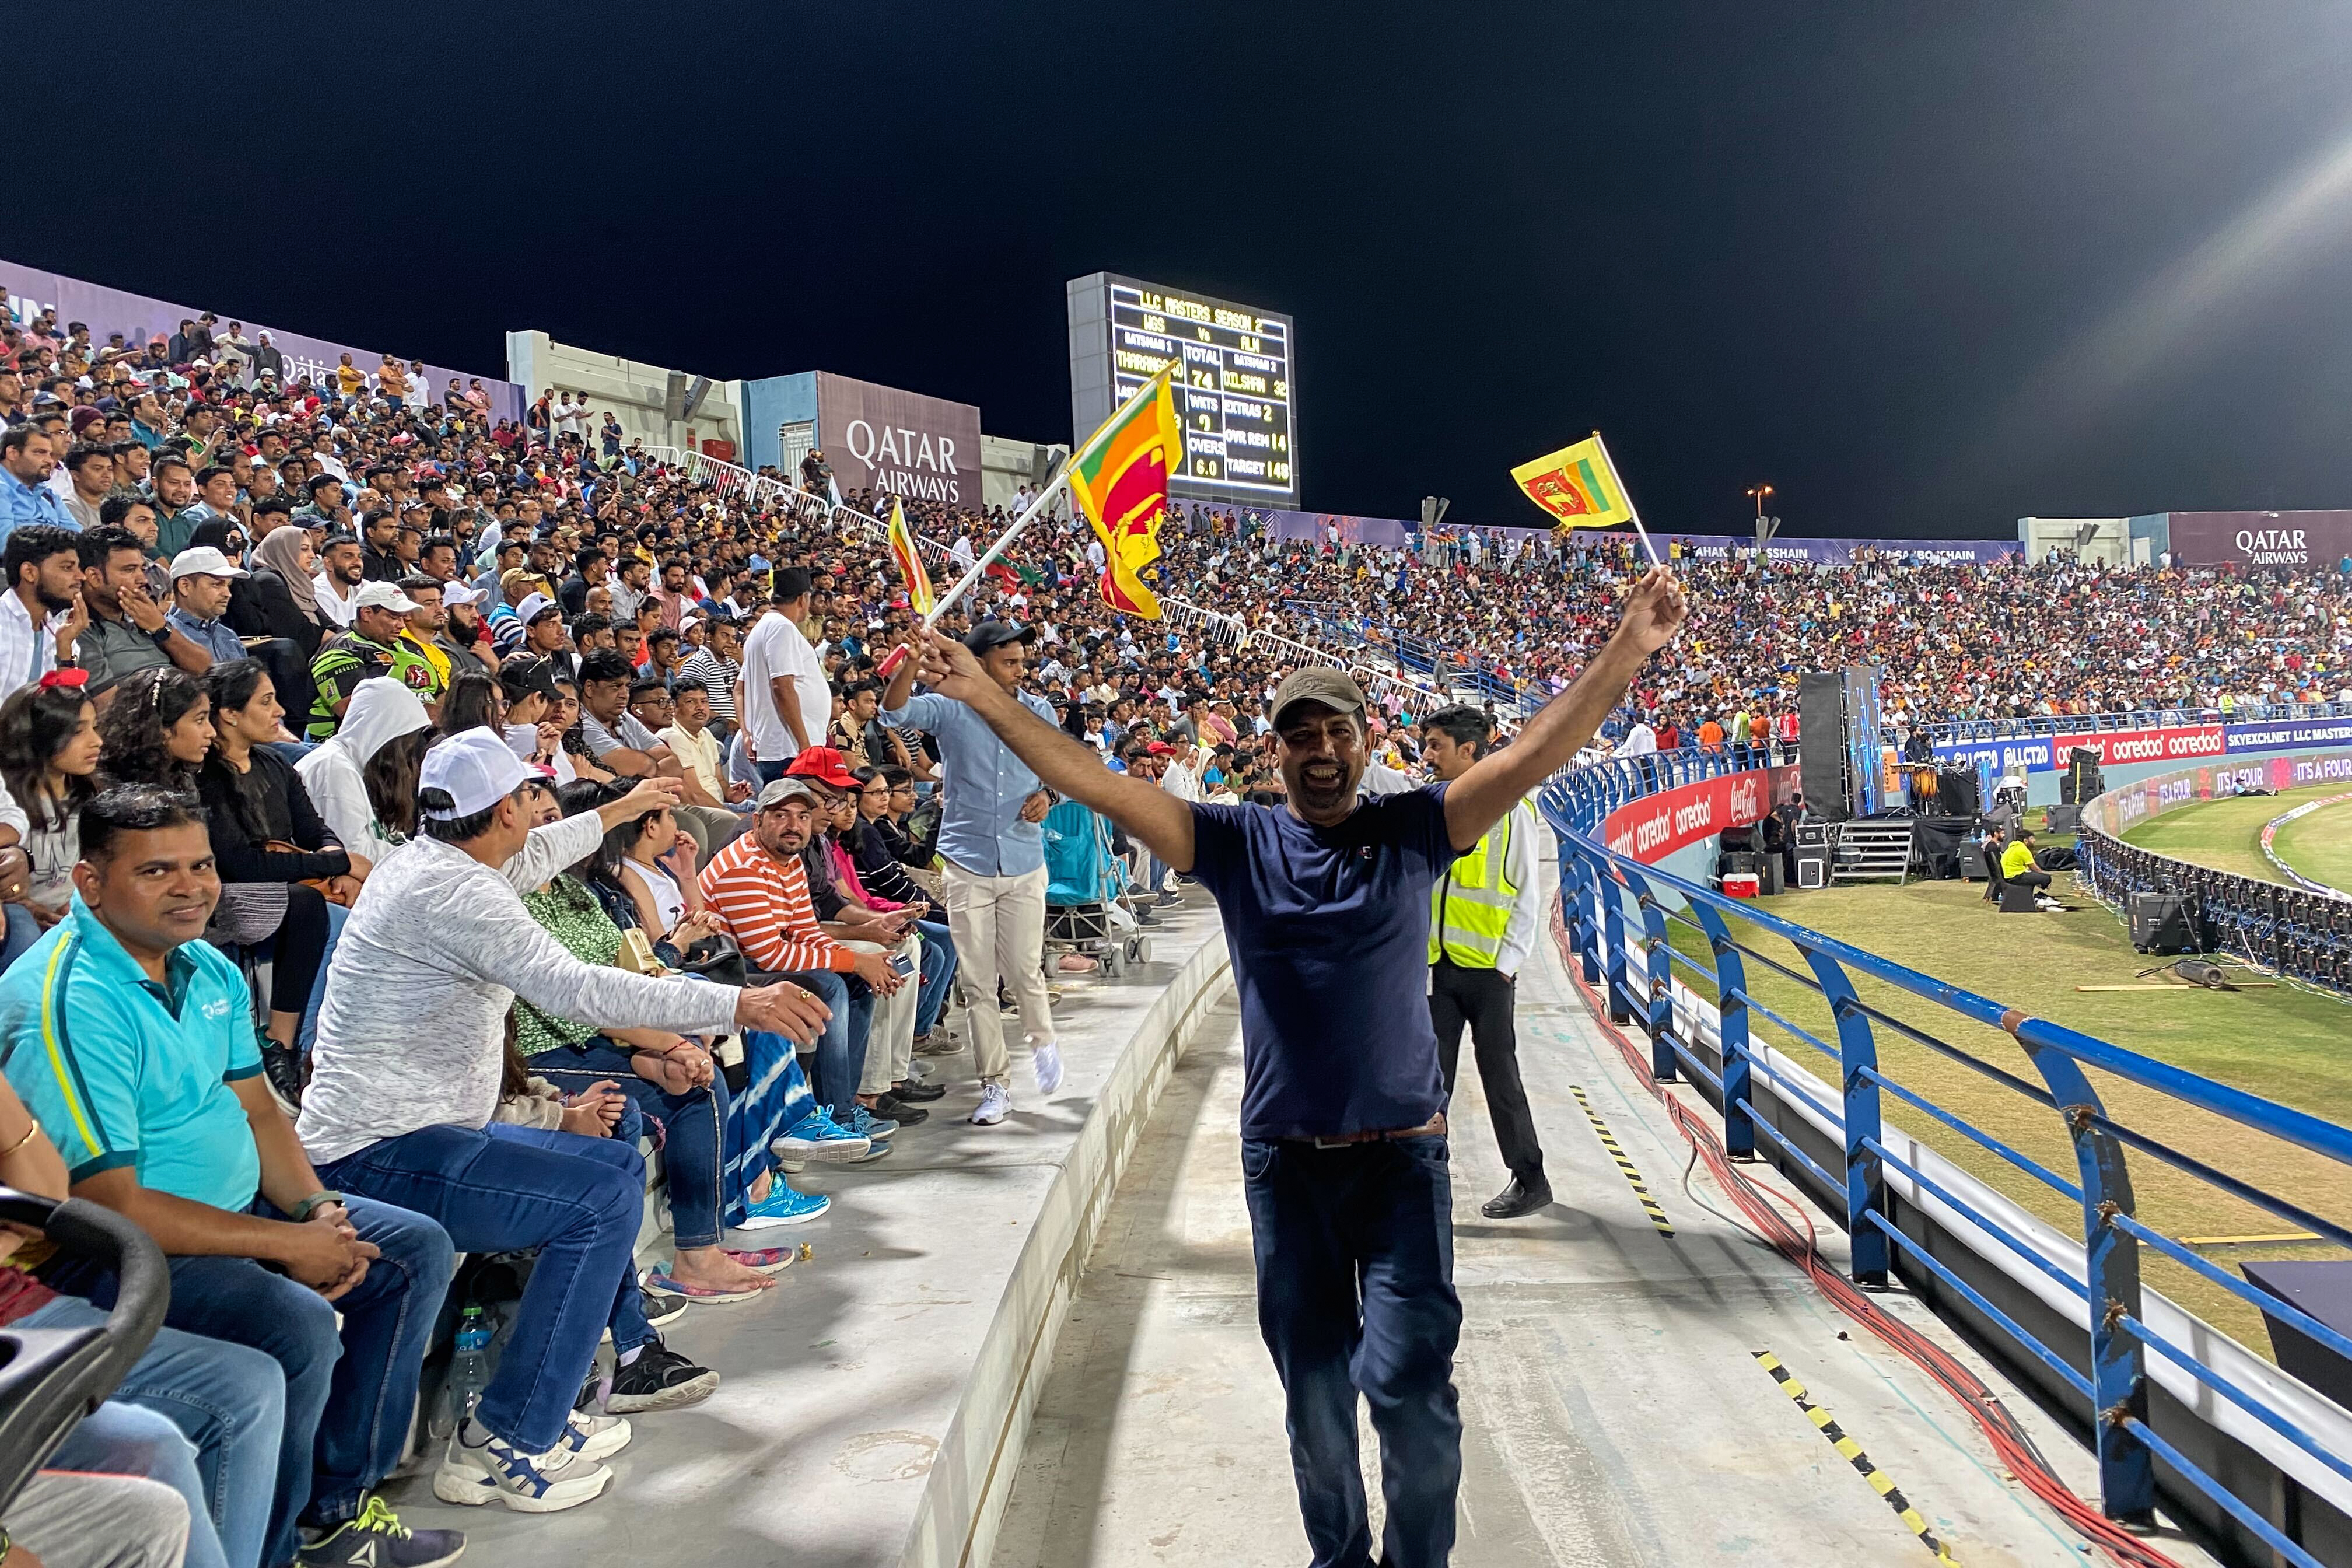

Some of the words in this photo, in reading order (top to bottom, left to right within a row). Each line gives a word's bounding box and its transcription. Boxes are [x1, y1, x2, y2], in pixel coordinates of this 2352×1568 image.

[1140, 292, 1161, 310] LLC
[1165, 296, 1211, 321] MASTERS
[1214, 308, 1252, 331] SEASON
[1255, 317, 1264, 334] 2
[1124, 331, 1166, 351] BATSMAN
[1185, 345, 1220, 366] TOTAL
[1234, 354, 1270, 371] BATSMAN
[1191, 369, 1213, 389] 74
[1223, 370, 1266, 393] DILSHAN
[1273, 380, 1287, 397] 32
[1189, 394, 1219, 412] WKTS
[1224, 399, 1262, 419] EXTRAS
[1262, 404, 1272, 422] 2
[846, 419, 958, 475] QATAR
[1189, 436, 1225, 456] OVERS
[1225, 429, 1247, 444] OVR
[1247, 432, 1270, 448] REM
[1271, 433, 1287, 452] 14
[1196, 458, 1218, 477] 6.0
[1227, 457, 1265, 476] TARGET
[1267, 460, 1290, 480] 148
[875, 468, 960, 503] AIRWAYS
[2235, 530, 2307, 555] QATAR
[2252, 551, 2308, 565] AIRWAYS
[2113, 734, 2164, 760] ooredoo
[2168, 729, 2222, 755] ooredoo
[2228, 730, 2291, 747] SKYEXCH.NET
[2293, 729, 2312, 742] LLC
[2003, 745, 2049, 767] @LLCT20
[2314, 761, 2324, 780] A
[2324, 758, 2352, 778] FOUR
[1636, 806, 1671, 855] ooredoo
[1675, 793, 1712, 836] ooredoo
